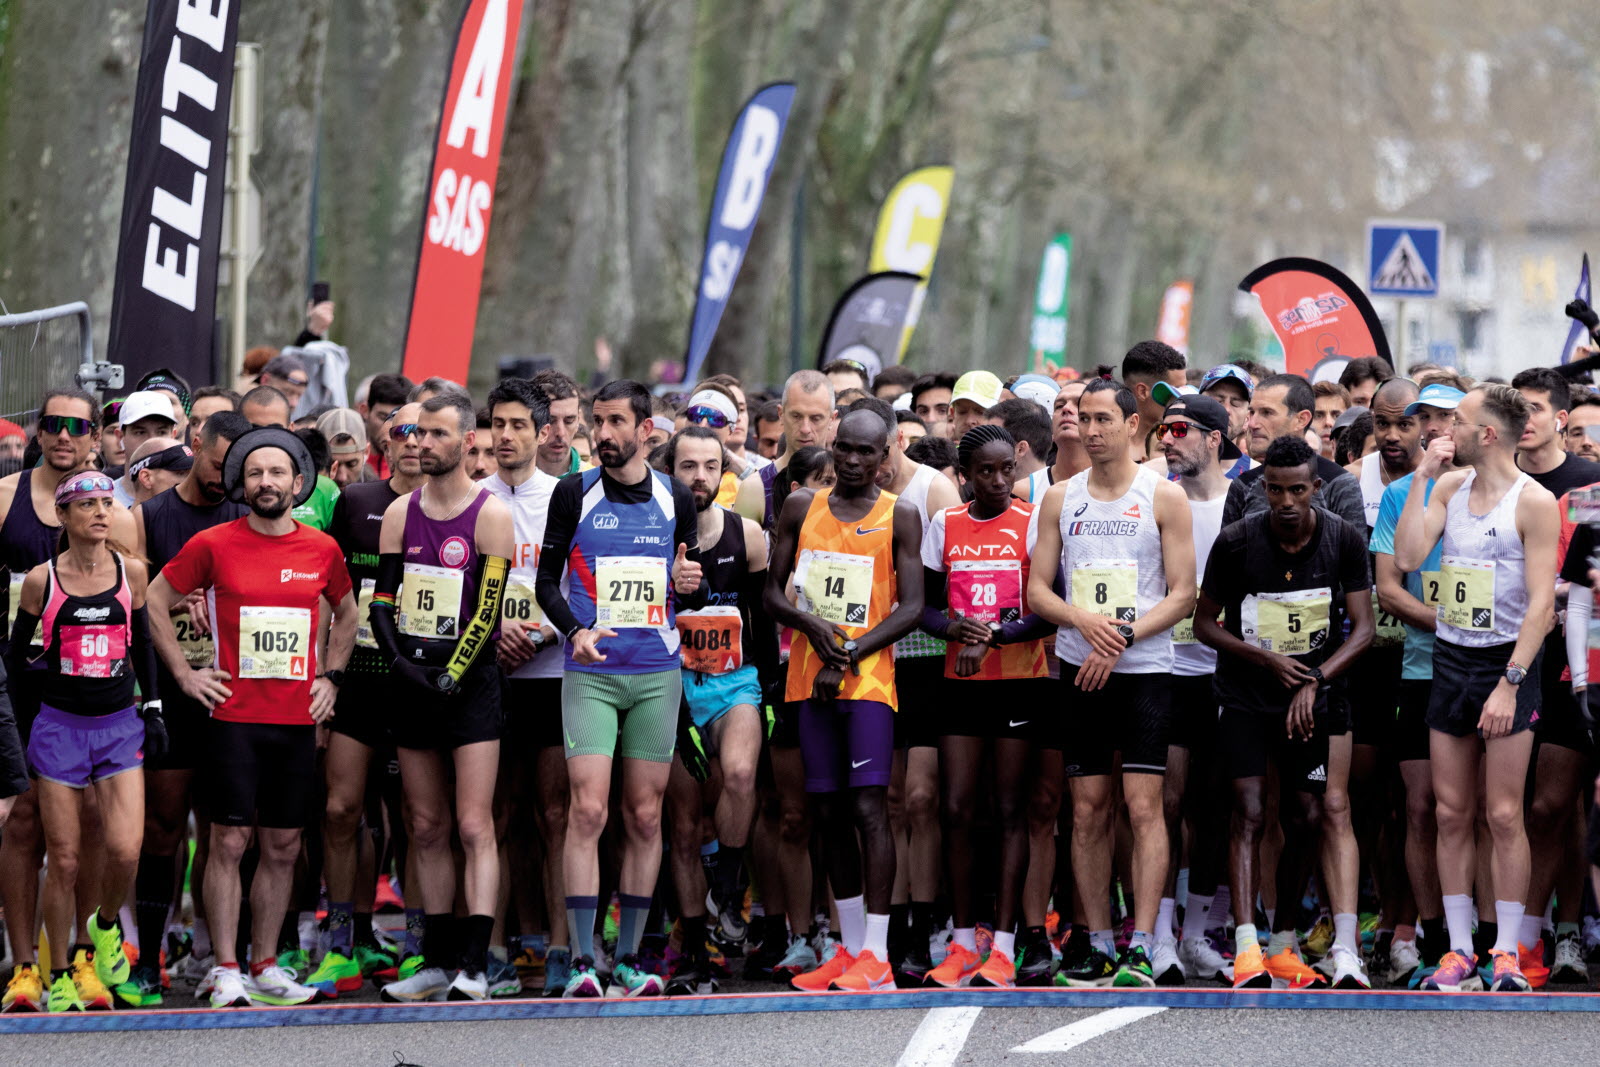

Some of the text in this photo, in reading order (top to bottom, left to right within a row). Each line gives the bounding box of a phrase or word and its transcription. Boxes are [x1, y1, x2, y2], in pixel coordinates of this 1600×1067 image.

[446, 0, 508, 158] A
[142, 0, 229, 312] ELITE
[720, 103, 780, 231] B
[428, 168, 491, 256] SAS
[883, 182, 943, 274] C
[1079, 521, 1138, 536] FRANCE
[633, 536, 660, 544] ATMB
[948, 545, 1018, 556] ANTA
[609, 580, 655, 603] 2775
[825, 576, 844, 599] 14
[970, 583, 997, 606] 28
[1095, 583, 1107, 604] 8
[1455, 581, 1466, 603] 6
[416, 588, 435, 612] 15
[650, 607, 661, 623] A
[847, 605, 866, 622] ELITE
[1119, 607, 1136, 623] LITE
[1288, 613, 1301, 633] 5
[1472, 609, 1491, 627] ELITE
[436, 617, 455, 635] ELITE
[81, 634, 109, 657] 50
[251, 631, 299, 653] 1052
[453, 622, 486, 668] TEAM
[680, 629, 732, 651] 4084
[1310, 629, 1326, 648] ELITE
[293, 658, 303, 674] A
[724, 655, 735, 671] A
[1307, 773, 1327, 782] adida
